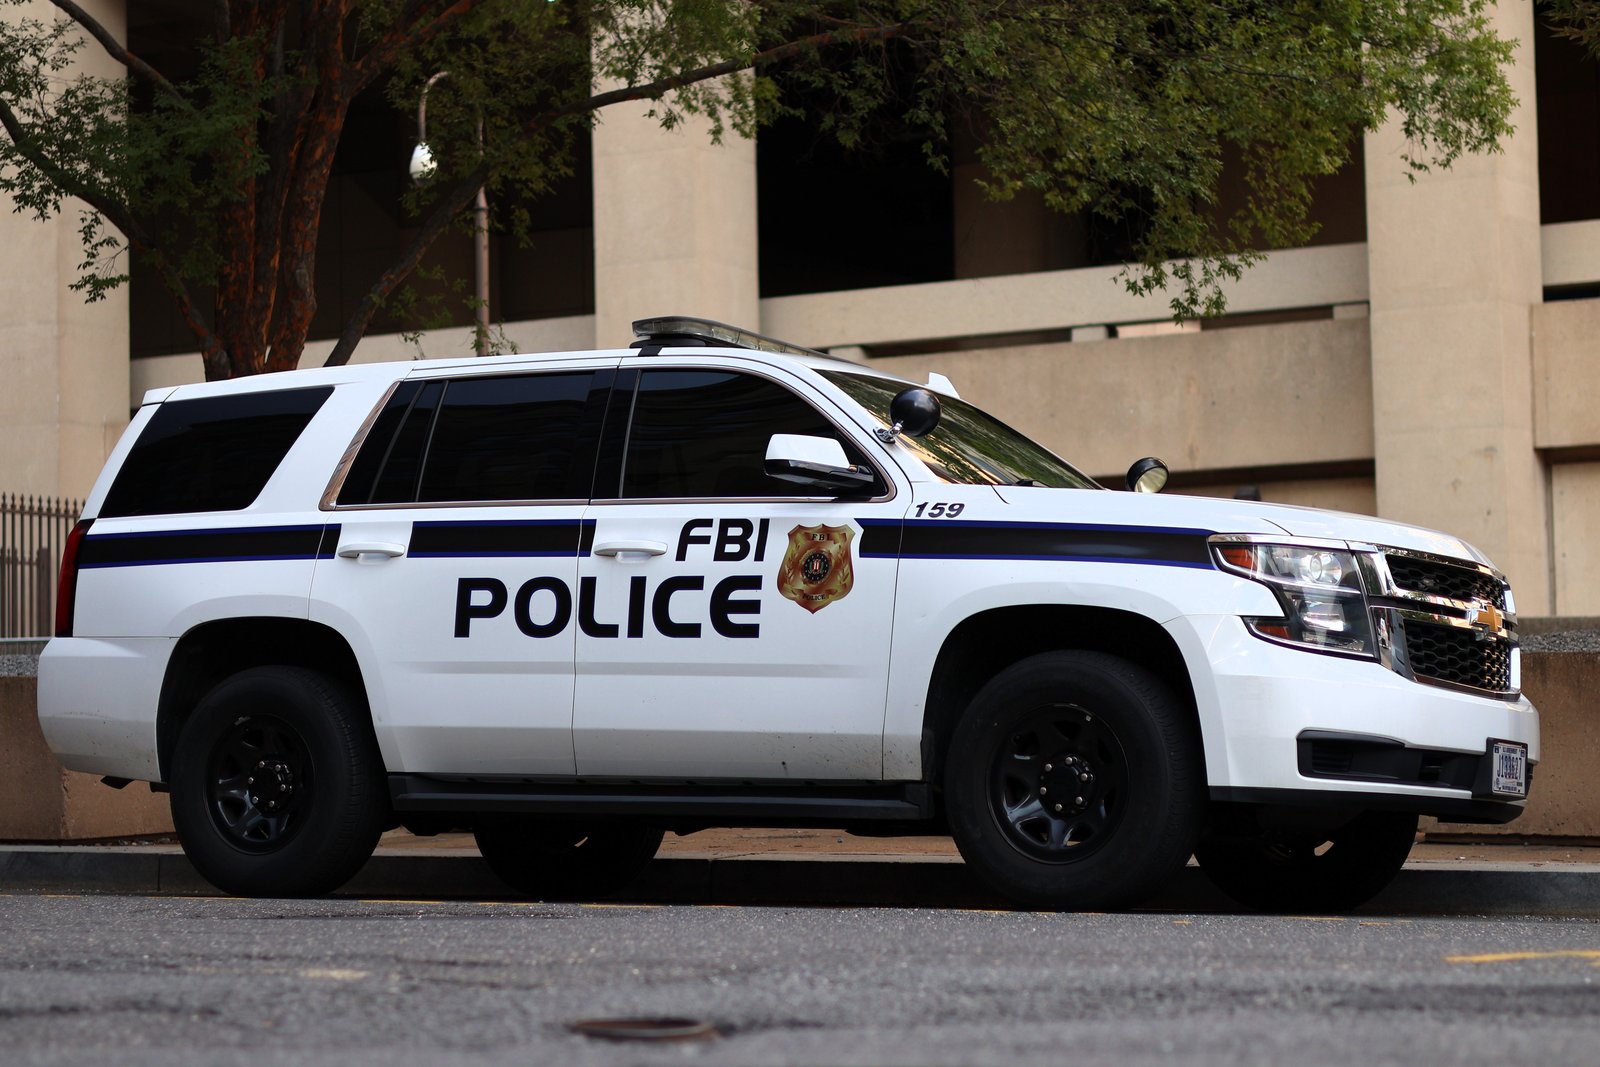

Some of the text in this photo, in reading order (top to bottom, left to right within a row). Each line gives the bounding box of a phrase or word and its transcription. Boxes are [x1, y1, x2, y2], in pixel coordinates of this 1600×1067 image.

[915, 501, 965, 518] 159
[676, 518, 770, 561] FBI
[812, 533, 831, 541] FBI
[455, 575, 763, 638] POLICE
